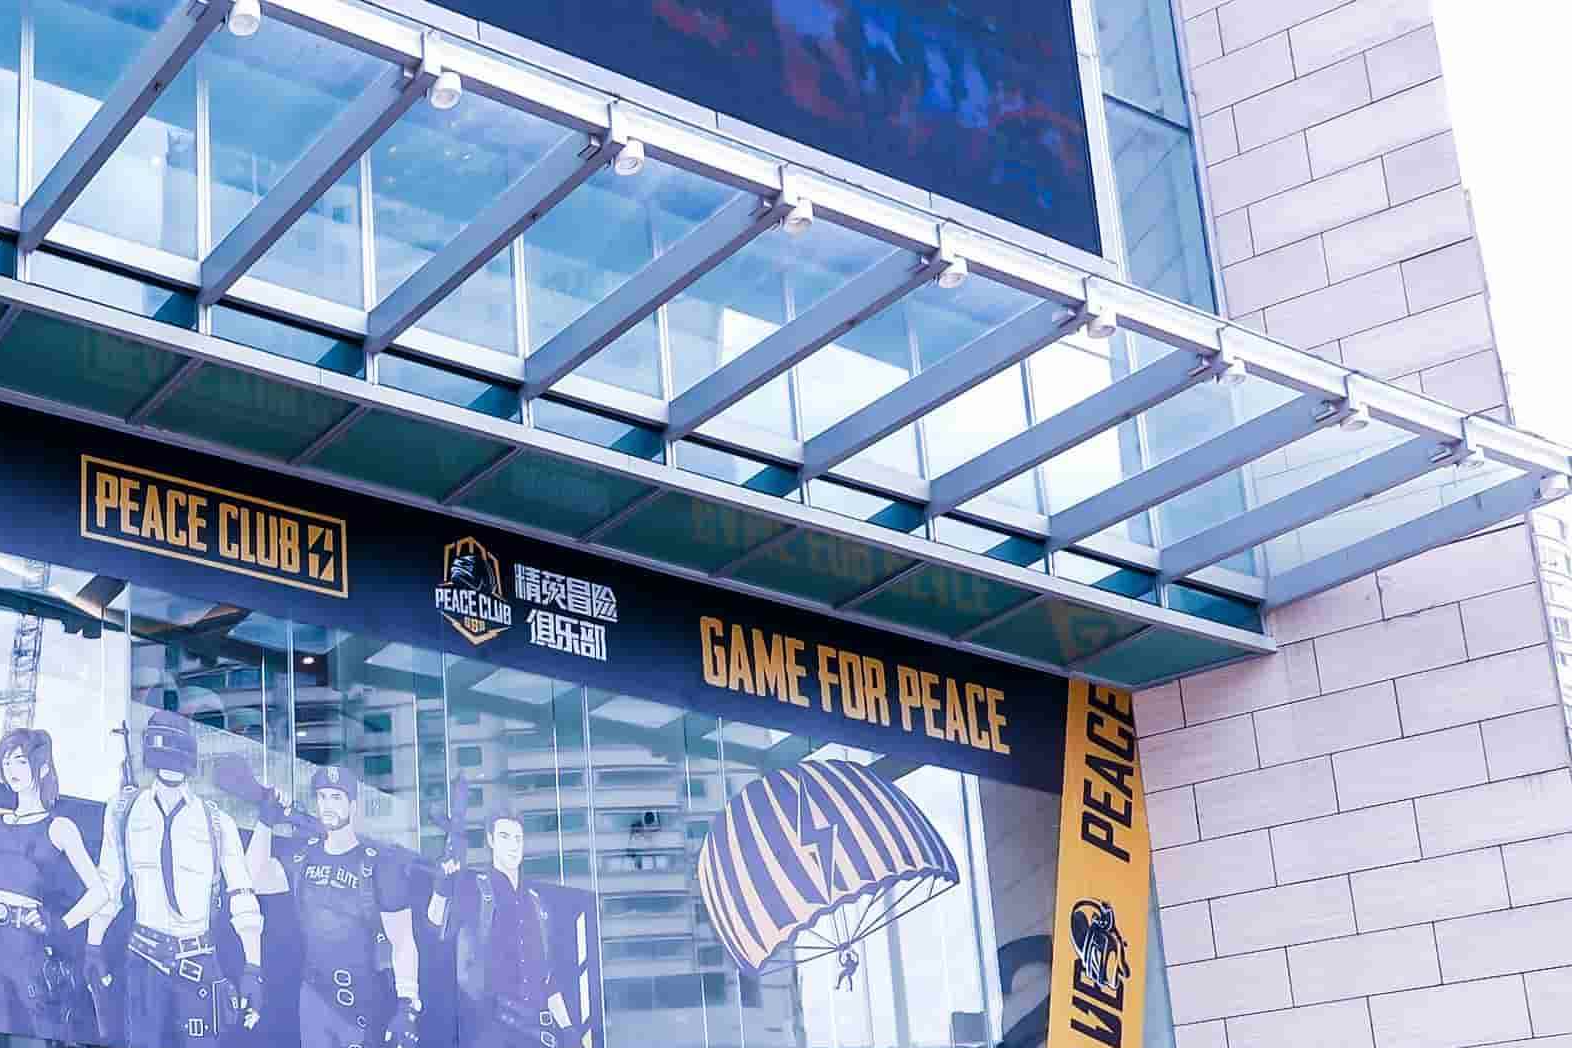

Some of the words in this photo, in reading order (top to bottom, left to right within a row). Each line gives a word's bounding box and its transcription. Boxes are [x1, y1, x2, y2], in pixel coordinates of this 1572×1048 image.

[94, 470, 208, 552] PEACE
[217, 501, 301, 575] CLUB
[435, 587, 477, 617] PEACE
[478, 593, 512, 625] CLUB
[514, 562, 618, 622] 精英冒险
[527, 608, 607, 662] 俱乐部
[698, 615, 810, 708] GAME
[814, 642, 891, 728] FOR
[896, 663, 1011, 755] PEACE
[1080, 681, 1134, 864] PEACE
